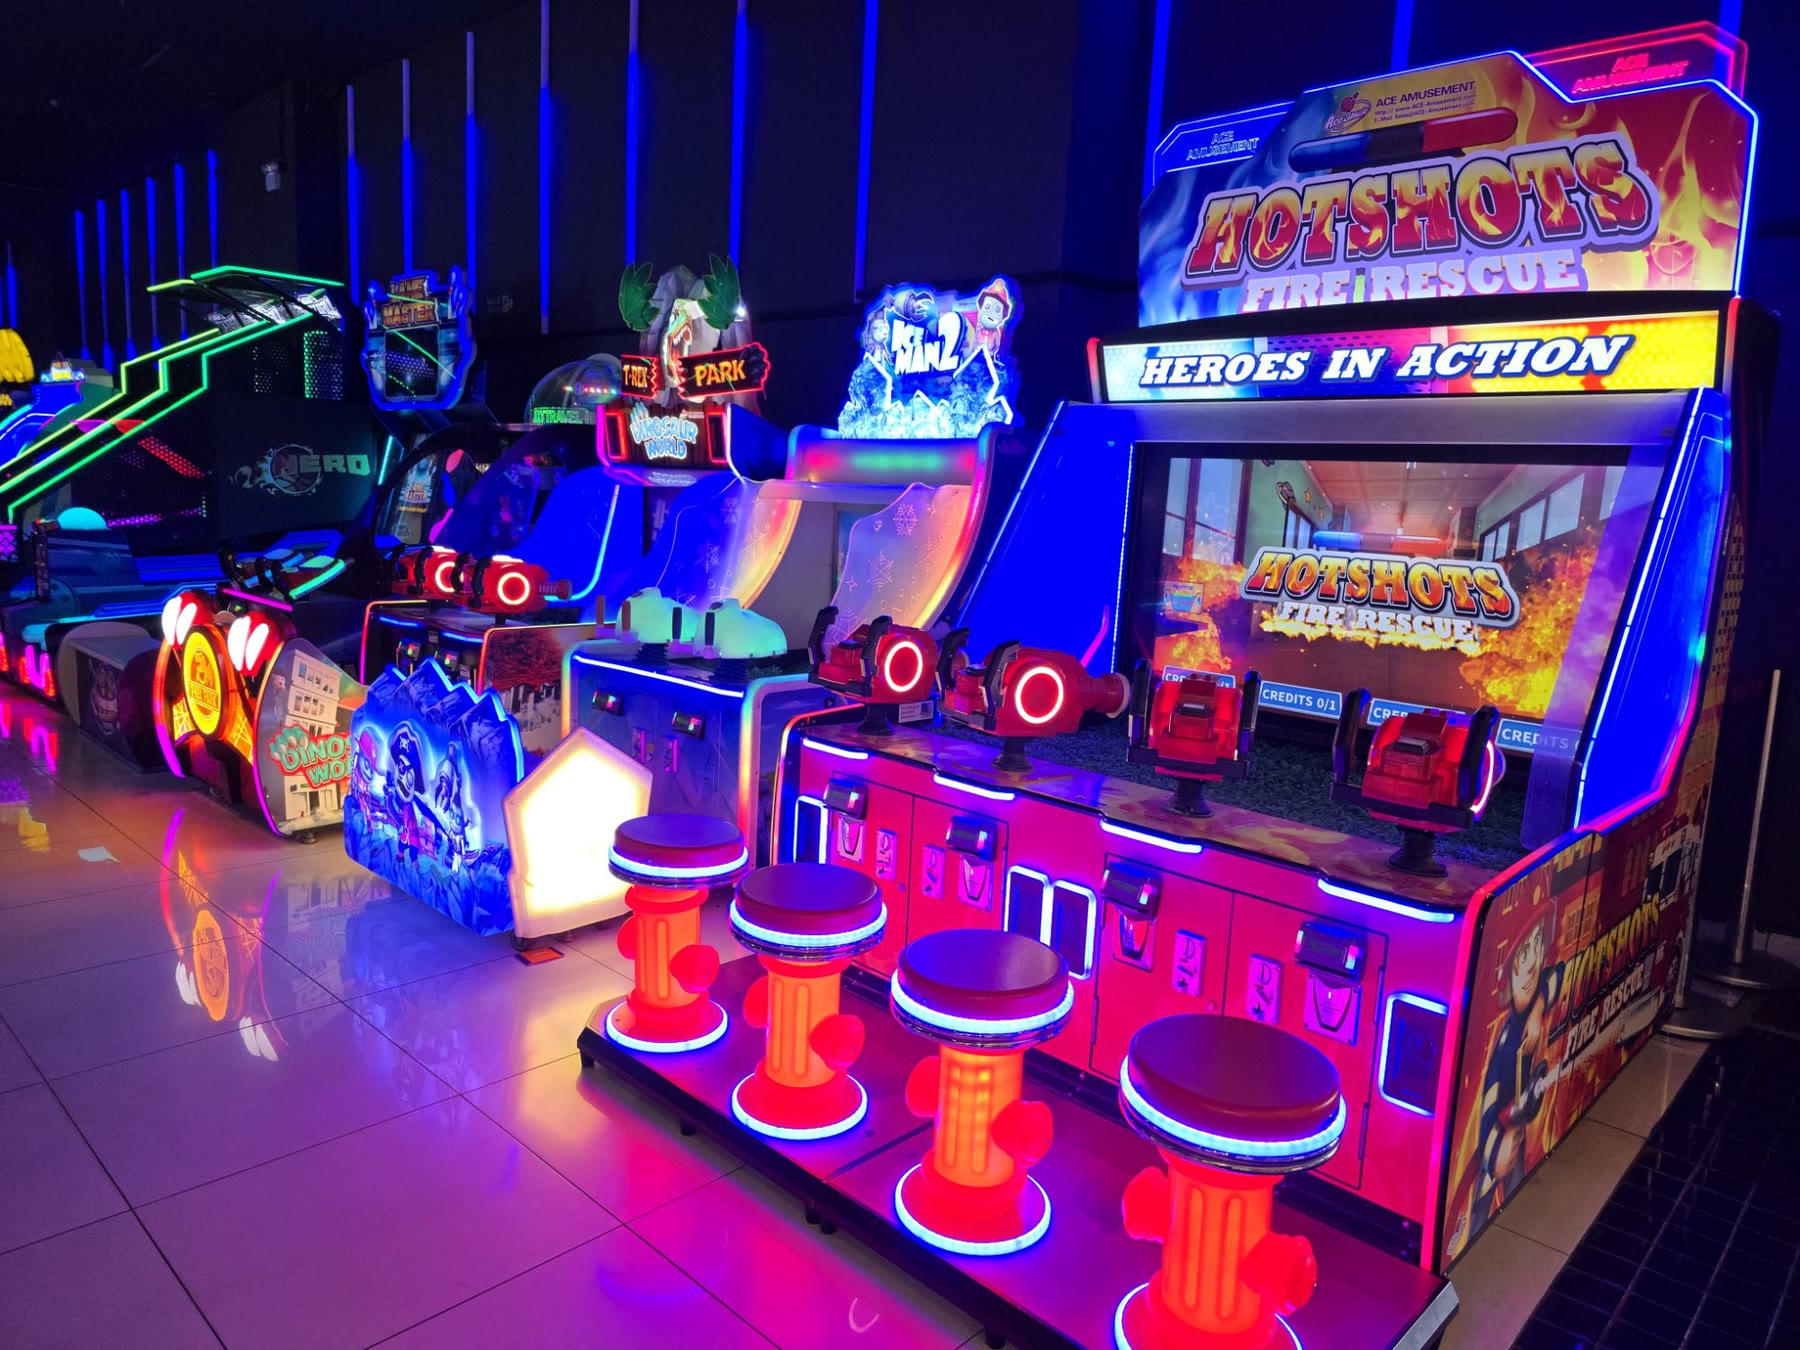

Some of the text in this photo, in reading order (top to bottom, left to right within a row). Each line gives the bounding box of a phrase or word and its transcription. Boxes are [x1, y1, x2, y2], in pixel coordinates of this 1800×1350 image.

[1572, 61, 1689, 93] AMUSEMENT
[1612, 53, 1649, 73] ACE
[1376, 80, 1475, 108] ACE AMUSEMENT
[1186, 137, 1260, 161] AMUSEMENT
[1211, 131, 1234, 145] ACE
[1187, 141, 1648, 275] HOTSHOTS
[1242, 248, 1581, 313] FIRE RESCUE
[891, 319, 925, 352] ICE
[694, 359, 746, 387] PARK
[895, 341, 940, 374] MAN
[1140, 335, 1636, 386] HEROES IN ACTION
[630, 416, 699, 444] DINOSAUR
[645, 437, 687, 459] WORLD
[1246, 551, 1513, 618] HOTSHOTS
[1280, 600, 1474, 642] FIRE RESCUE
[1262, 688, 1336, 711] CREDITS 0/1
[1501, 728, 1569, 749] CREDITS
[1554, 893, 1660, 1030] HOTSHOTS
[1601, 965, 1645, 1025] RESCUE
